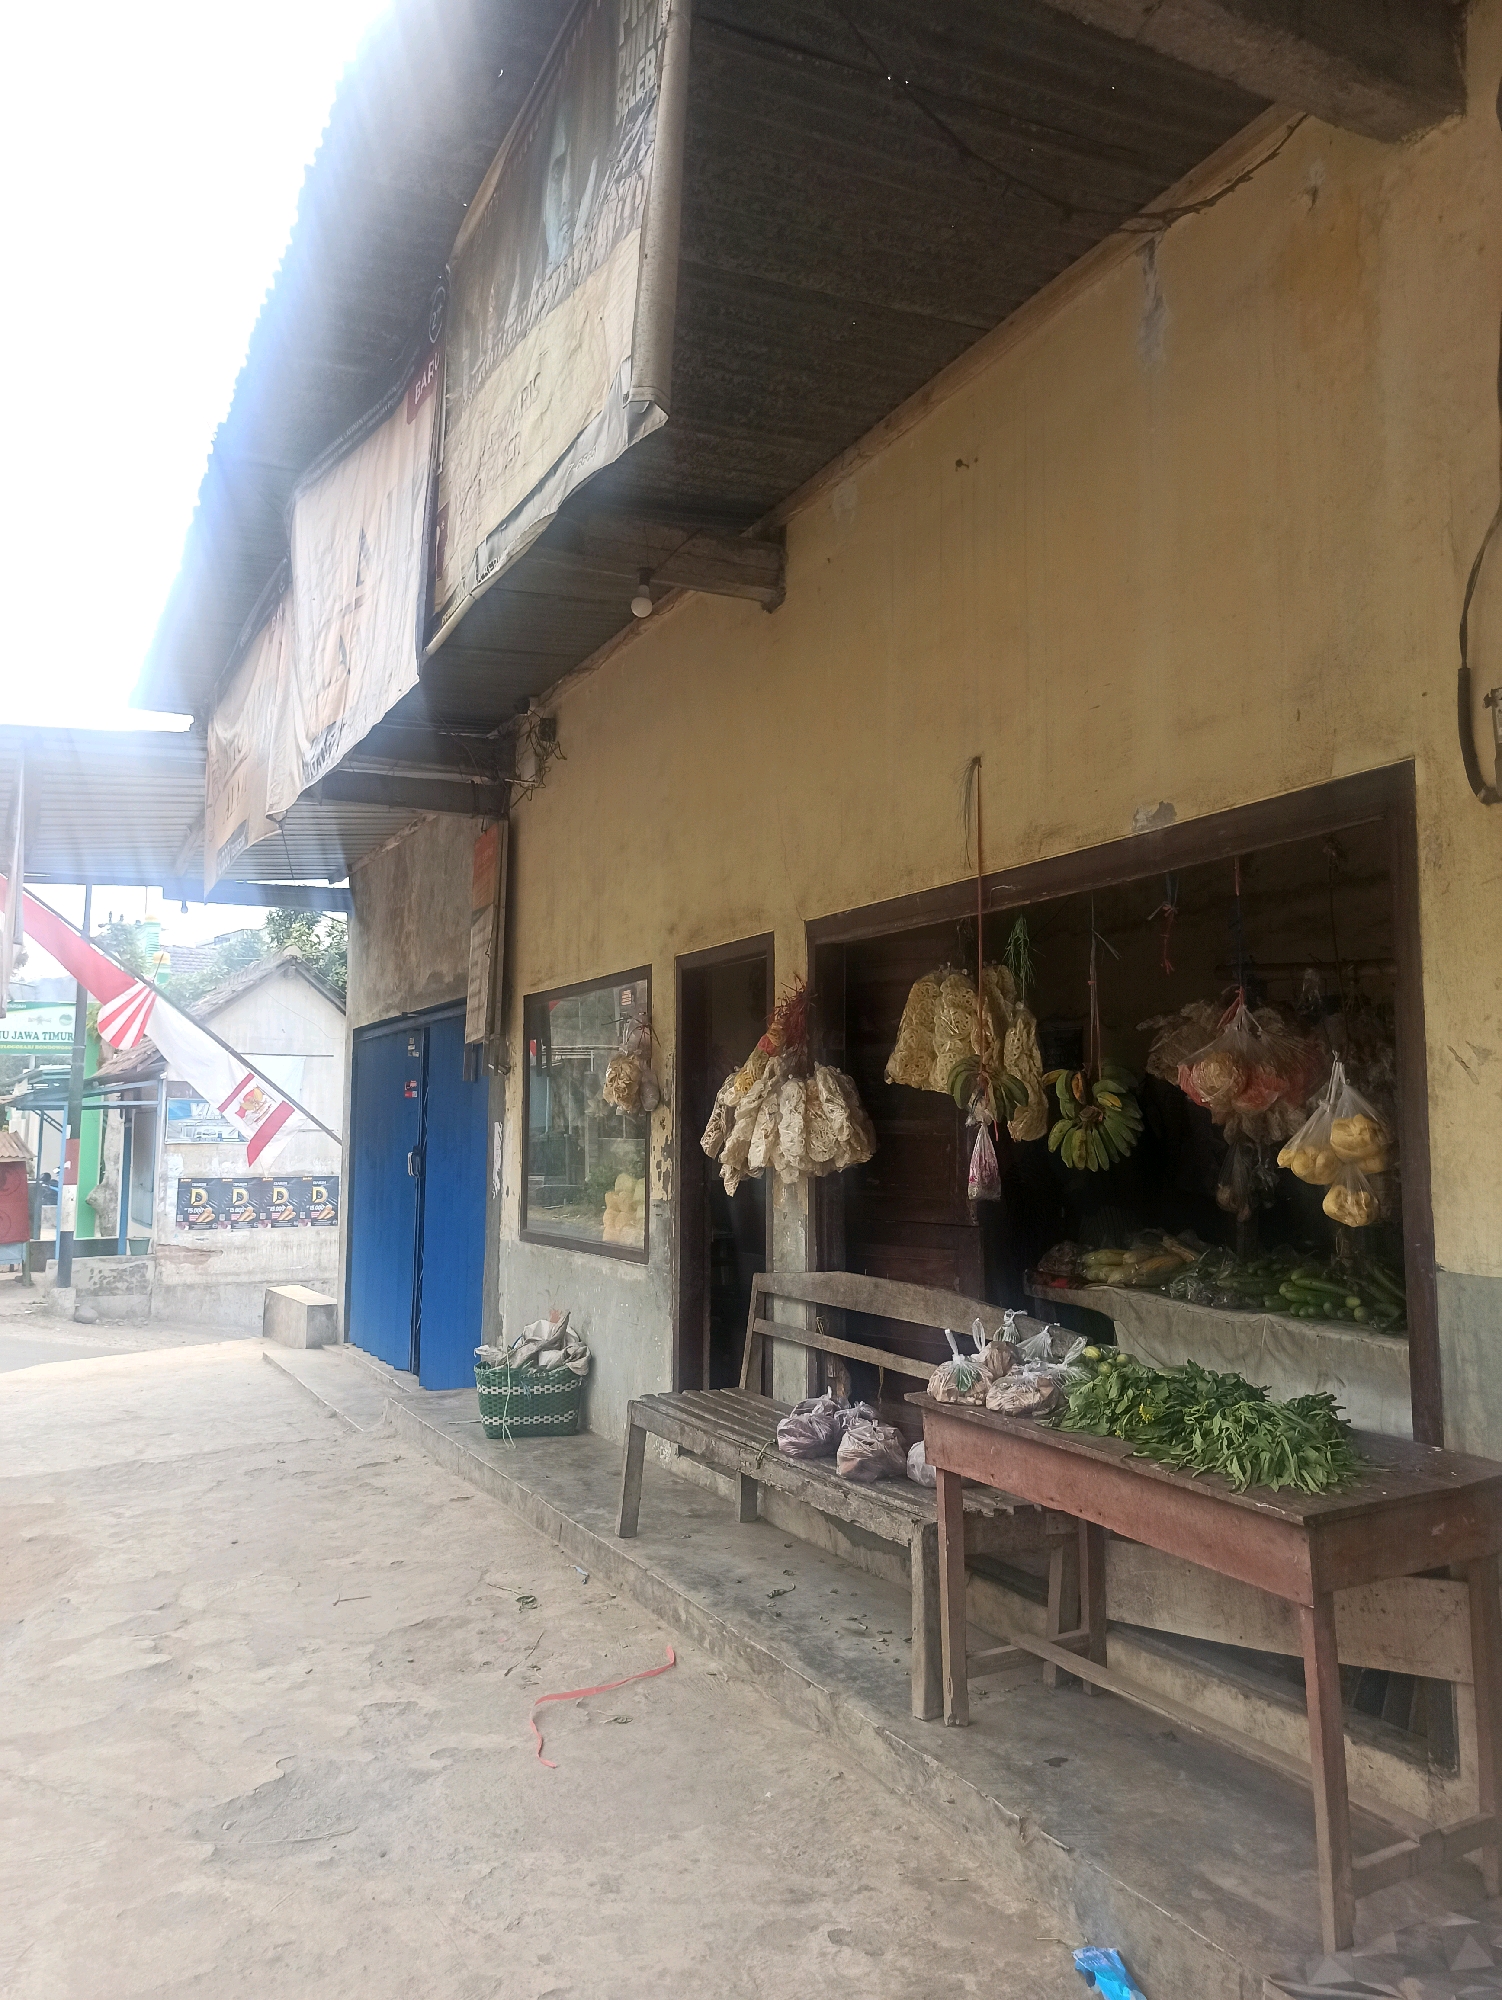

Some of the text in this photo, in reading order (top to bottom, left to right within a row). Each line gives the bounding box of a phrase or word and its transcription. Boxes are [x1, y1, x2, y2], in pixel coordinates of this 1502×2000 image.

[415, 352, 440, 405] BARU
[12, 1031, 40, 1041] JAWA
[42, 1031, 75, 1041] TIMUR
